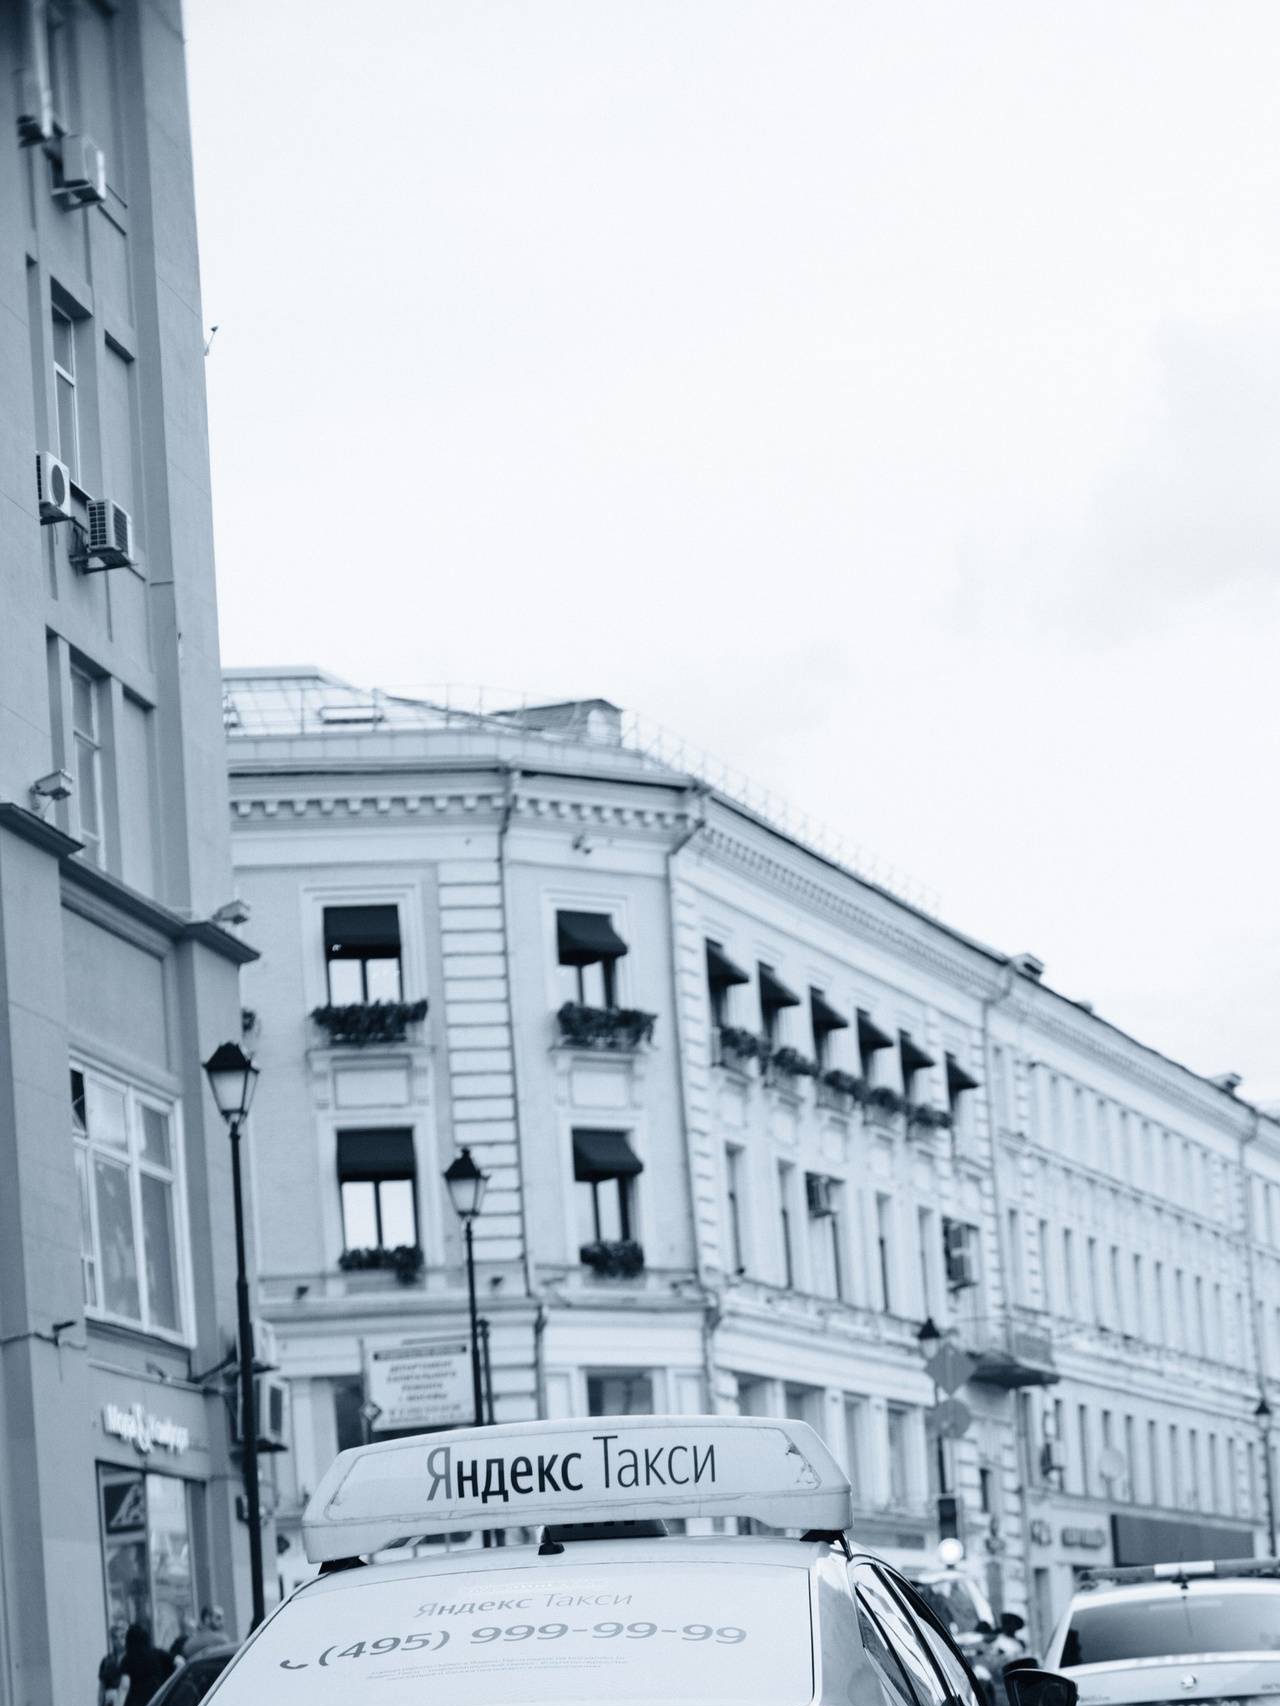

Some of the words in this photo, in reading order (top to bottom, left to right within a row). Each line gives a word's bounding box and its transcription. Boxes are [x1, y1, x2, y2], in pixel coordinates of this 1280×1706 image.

[426, 1446, 583, 1503] Яндекс
[592, 1435, 716, 1488] Такси
[414, 1598, 533, 1619] Яндекс
[545, 1593, 632, 1608] Такси
[319, 1630, 451, 1667] (495)
[470, 1621, 747, 1645] 999-99-99
